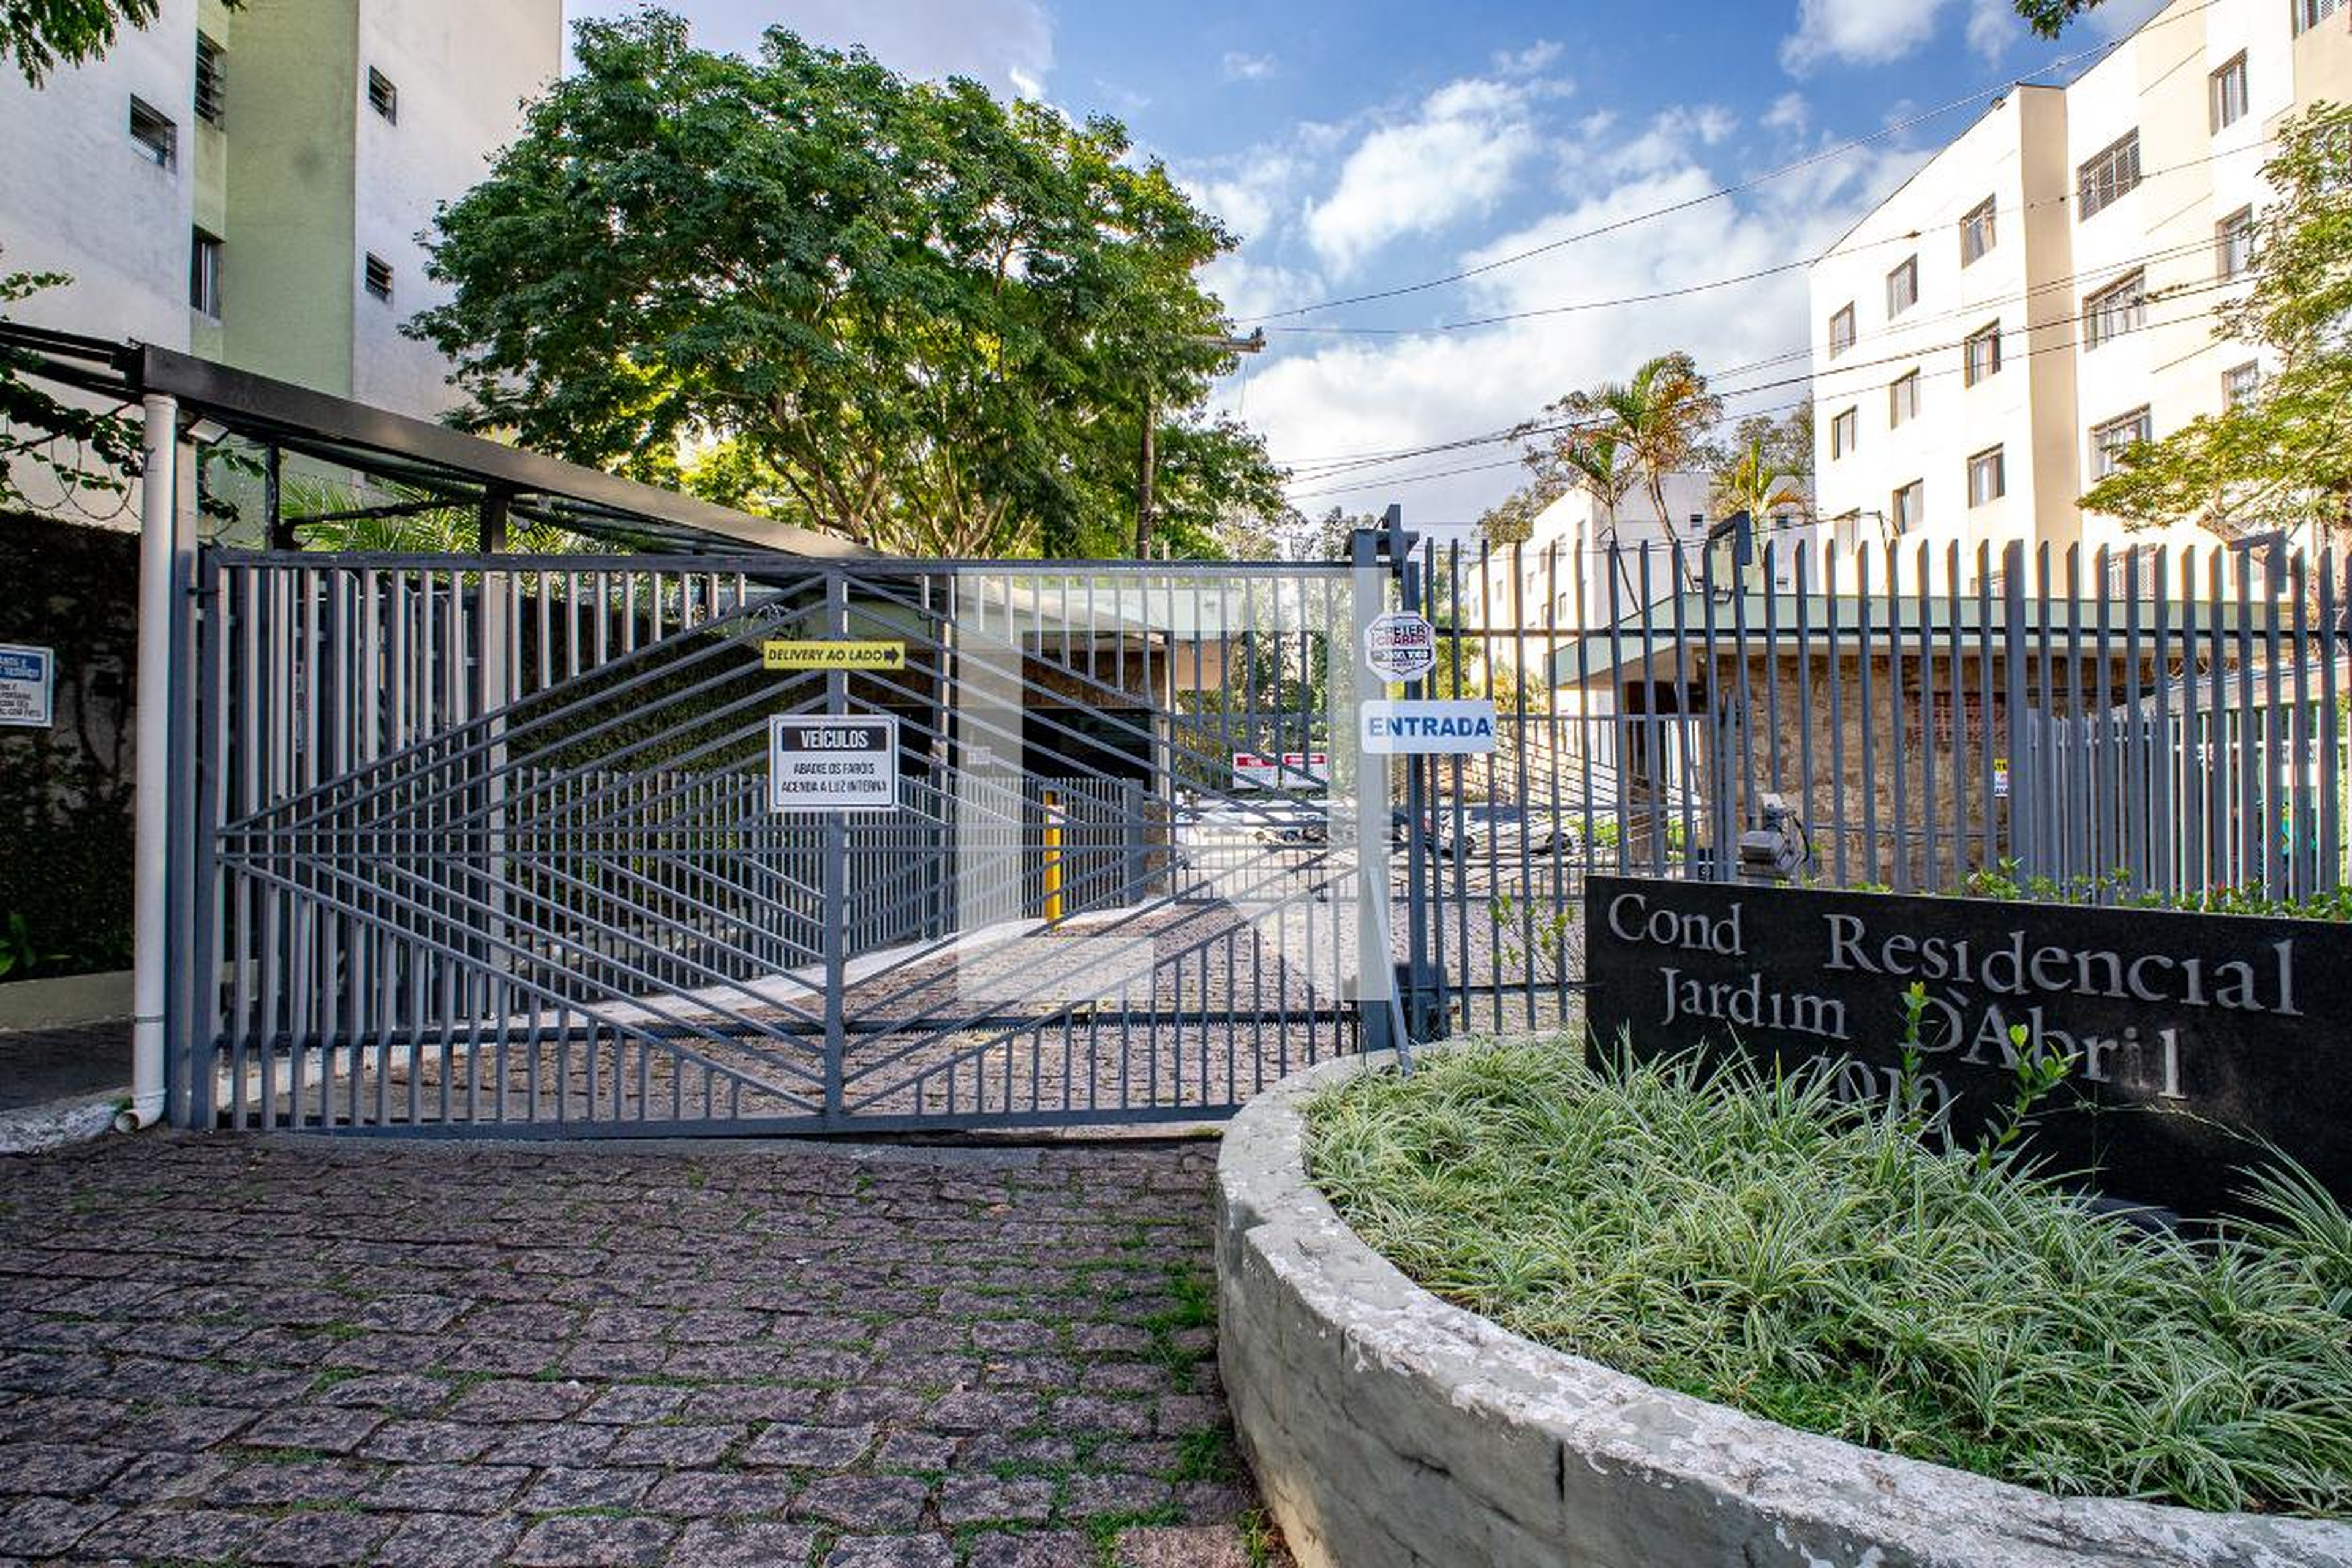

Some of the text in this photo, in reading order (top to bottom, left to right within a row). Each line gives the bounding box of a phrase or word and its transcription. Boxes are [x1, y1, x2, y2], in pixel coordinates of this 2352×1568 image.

[769, 649, 882, 661] DELIVERY AO LADO
[1369, 717, 1491, 736] ENTRADA
[801, 727, 869, 748] VEÍCULOS
[793, 763, 827, 775] ABAIXE
[829, 763, 842, 775] OS
[782, 781, 819, 793] ACENDA
[1608, 893, 2304, 1016] Cond Residencial
[1659, 968, 1851, 1041] Jardim
